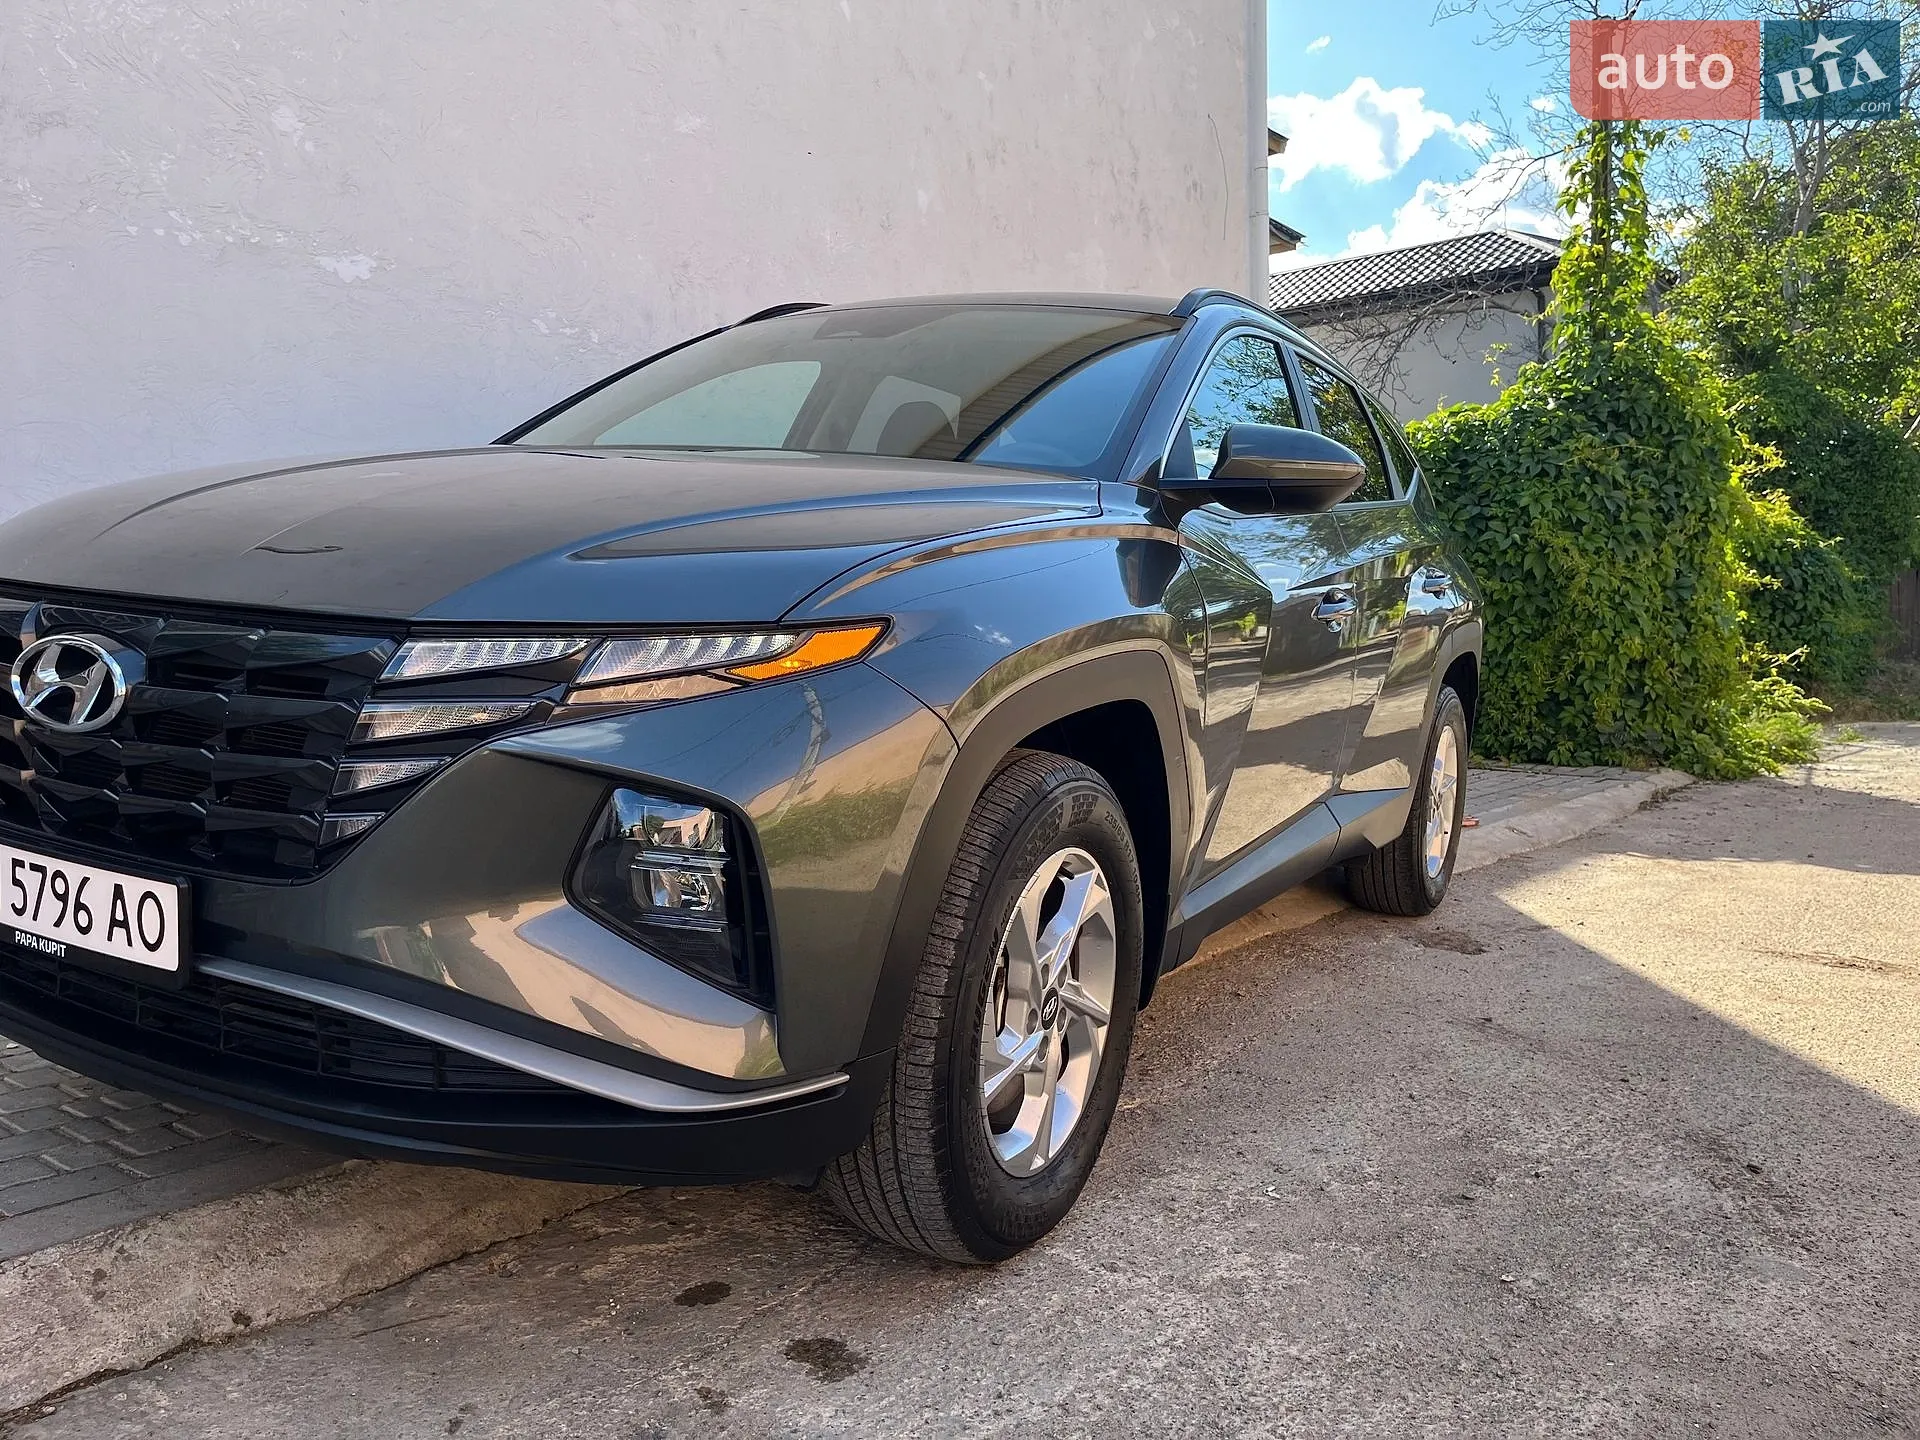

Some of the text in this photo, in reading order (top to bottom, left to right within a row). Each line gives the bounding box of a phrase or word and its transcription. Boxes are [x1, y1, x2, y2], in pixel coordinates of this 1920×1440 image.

[11, 858, 165, 952] 5796 AO
[15, 930, 67, 958] PAPA KUPIT
